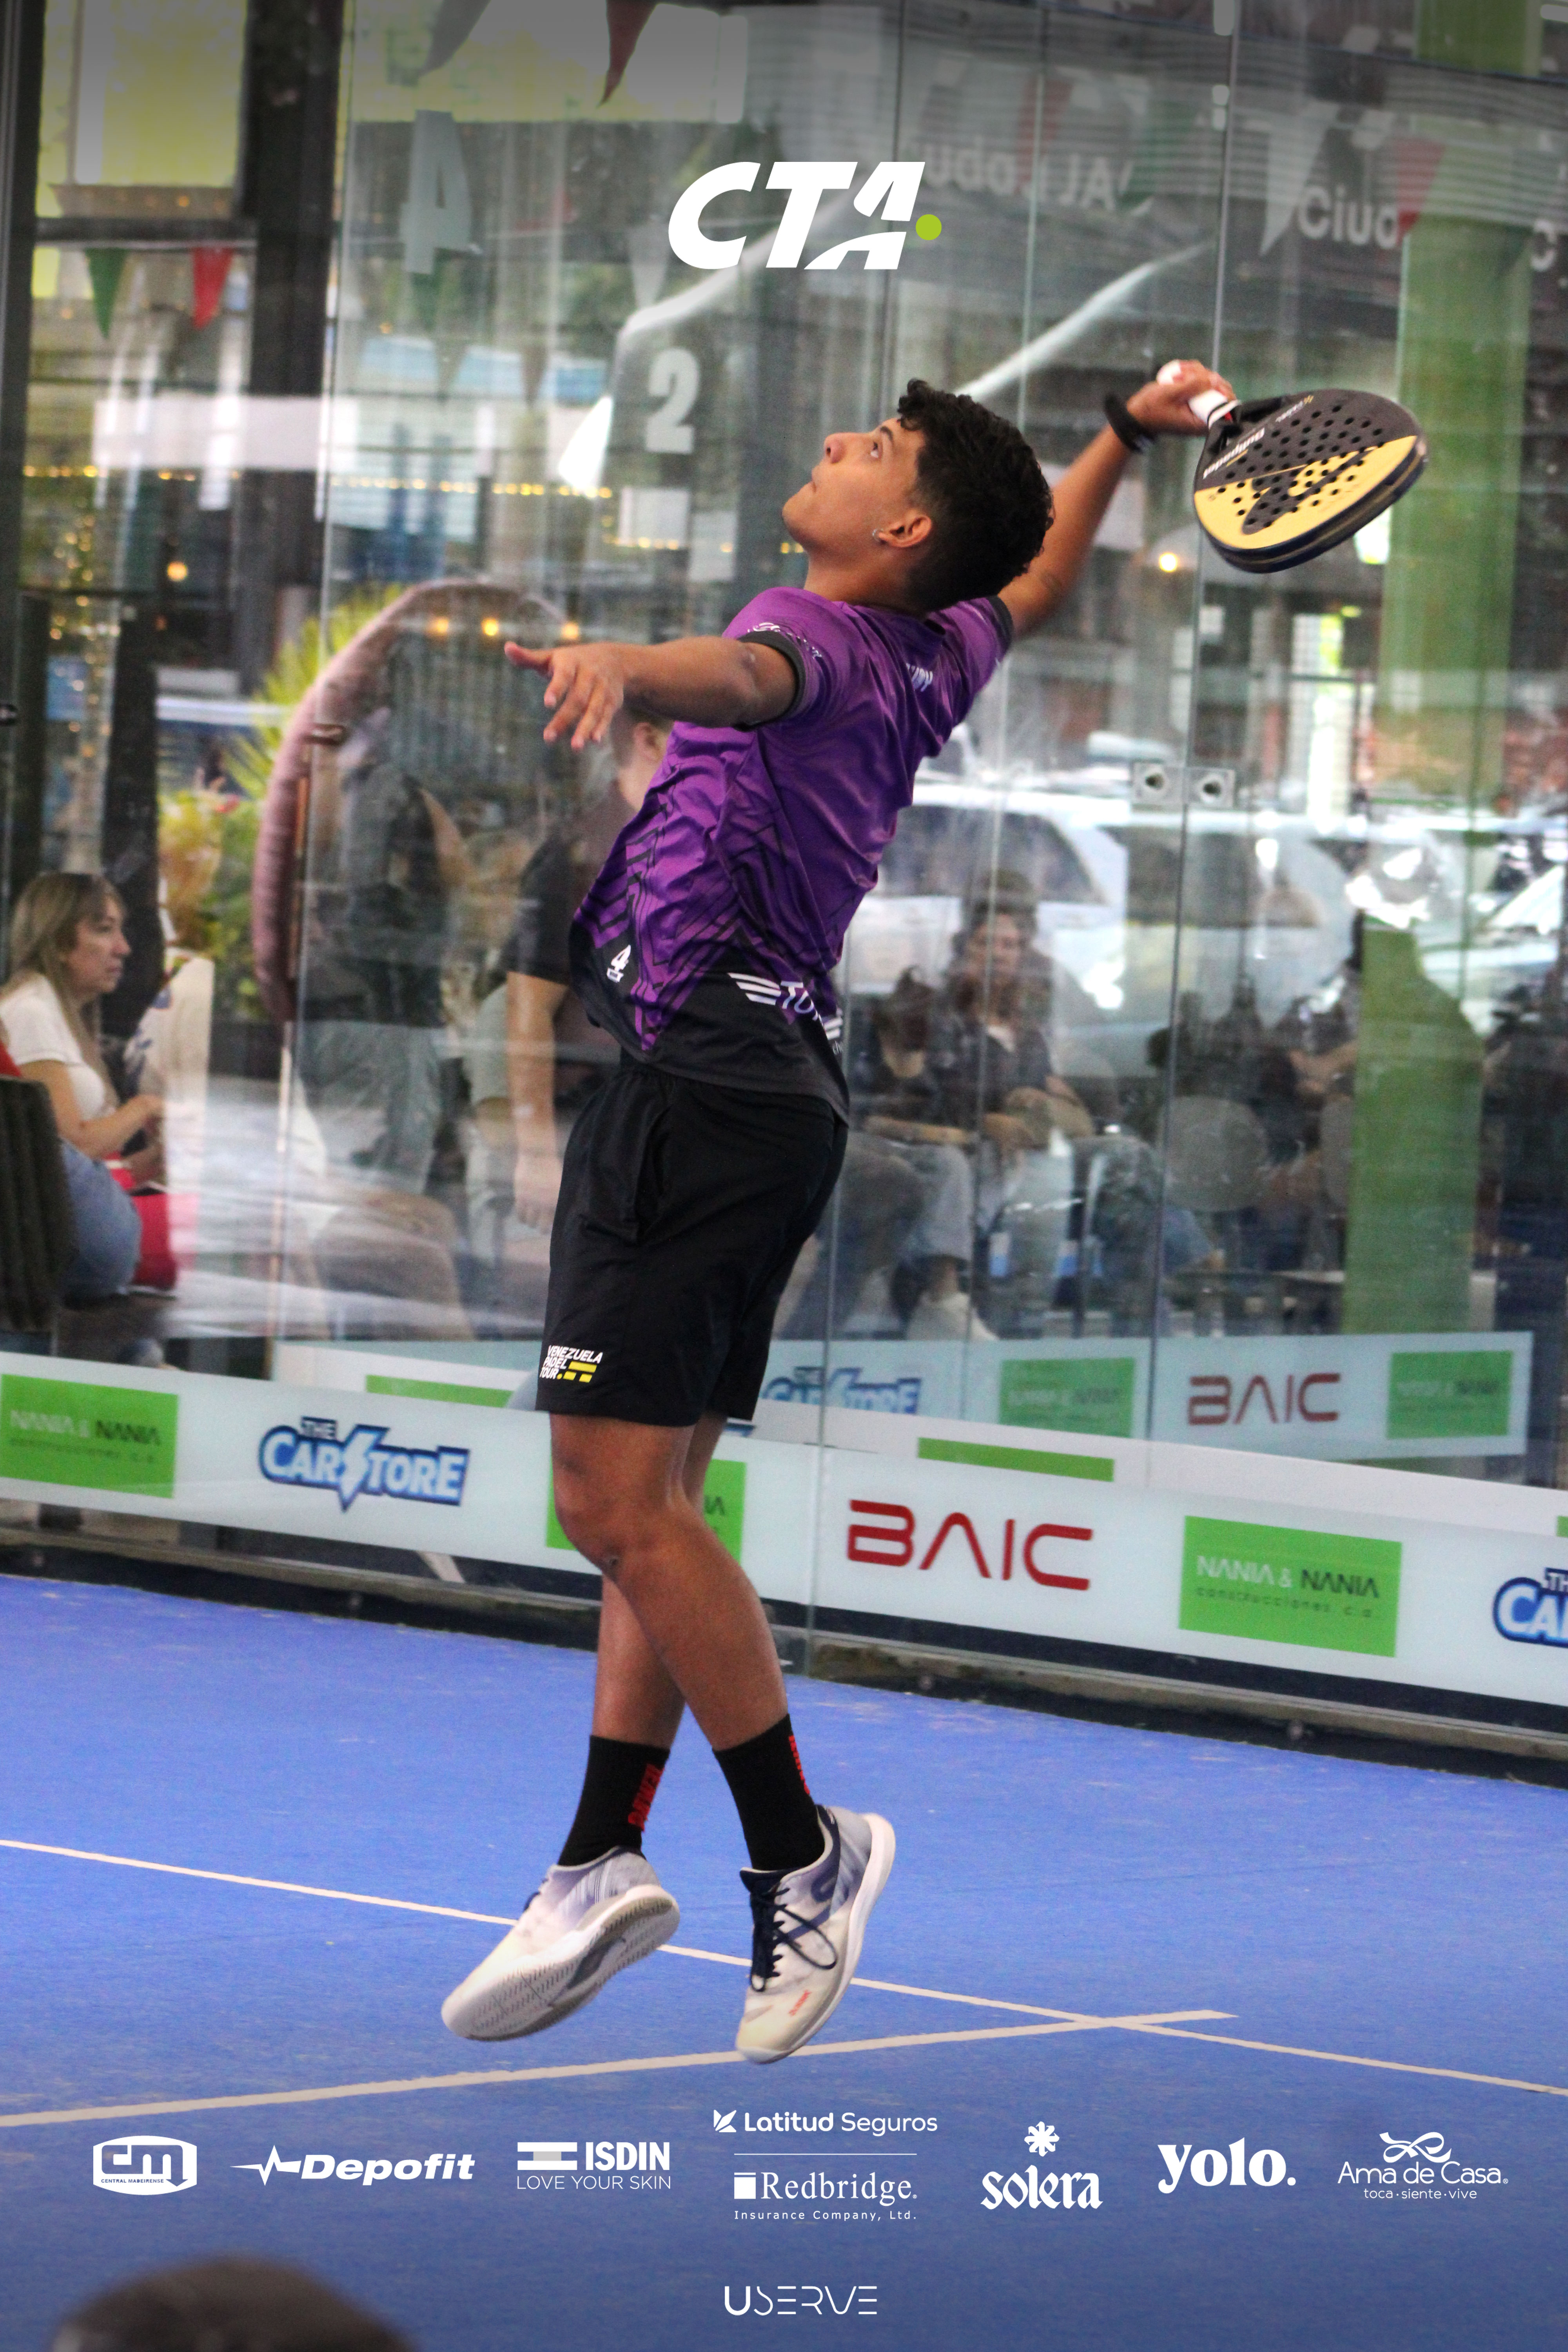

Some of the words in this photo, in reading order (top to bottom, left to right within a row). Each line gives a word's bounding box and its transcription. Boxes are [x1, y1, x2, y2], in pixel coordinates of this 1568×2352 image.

[646, 348, 700, 454] 2
[543, 1356, 568, 1369] PADEL
[548, 1345, 603, 1364] VENEZUELA
[1187, 1373, 1341, 1425] BAIC
[848, 1499, 1093, 1591] BAIC
[1197, 1555, 1275, 1586] NANIA
[1278, 1568, 1292, 1588] &
[1300, 1569, 1380, 1598] NANIA
